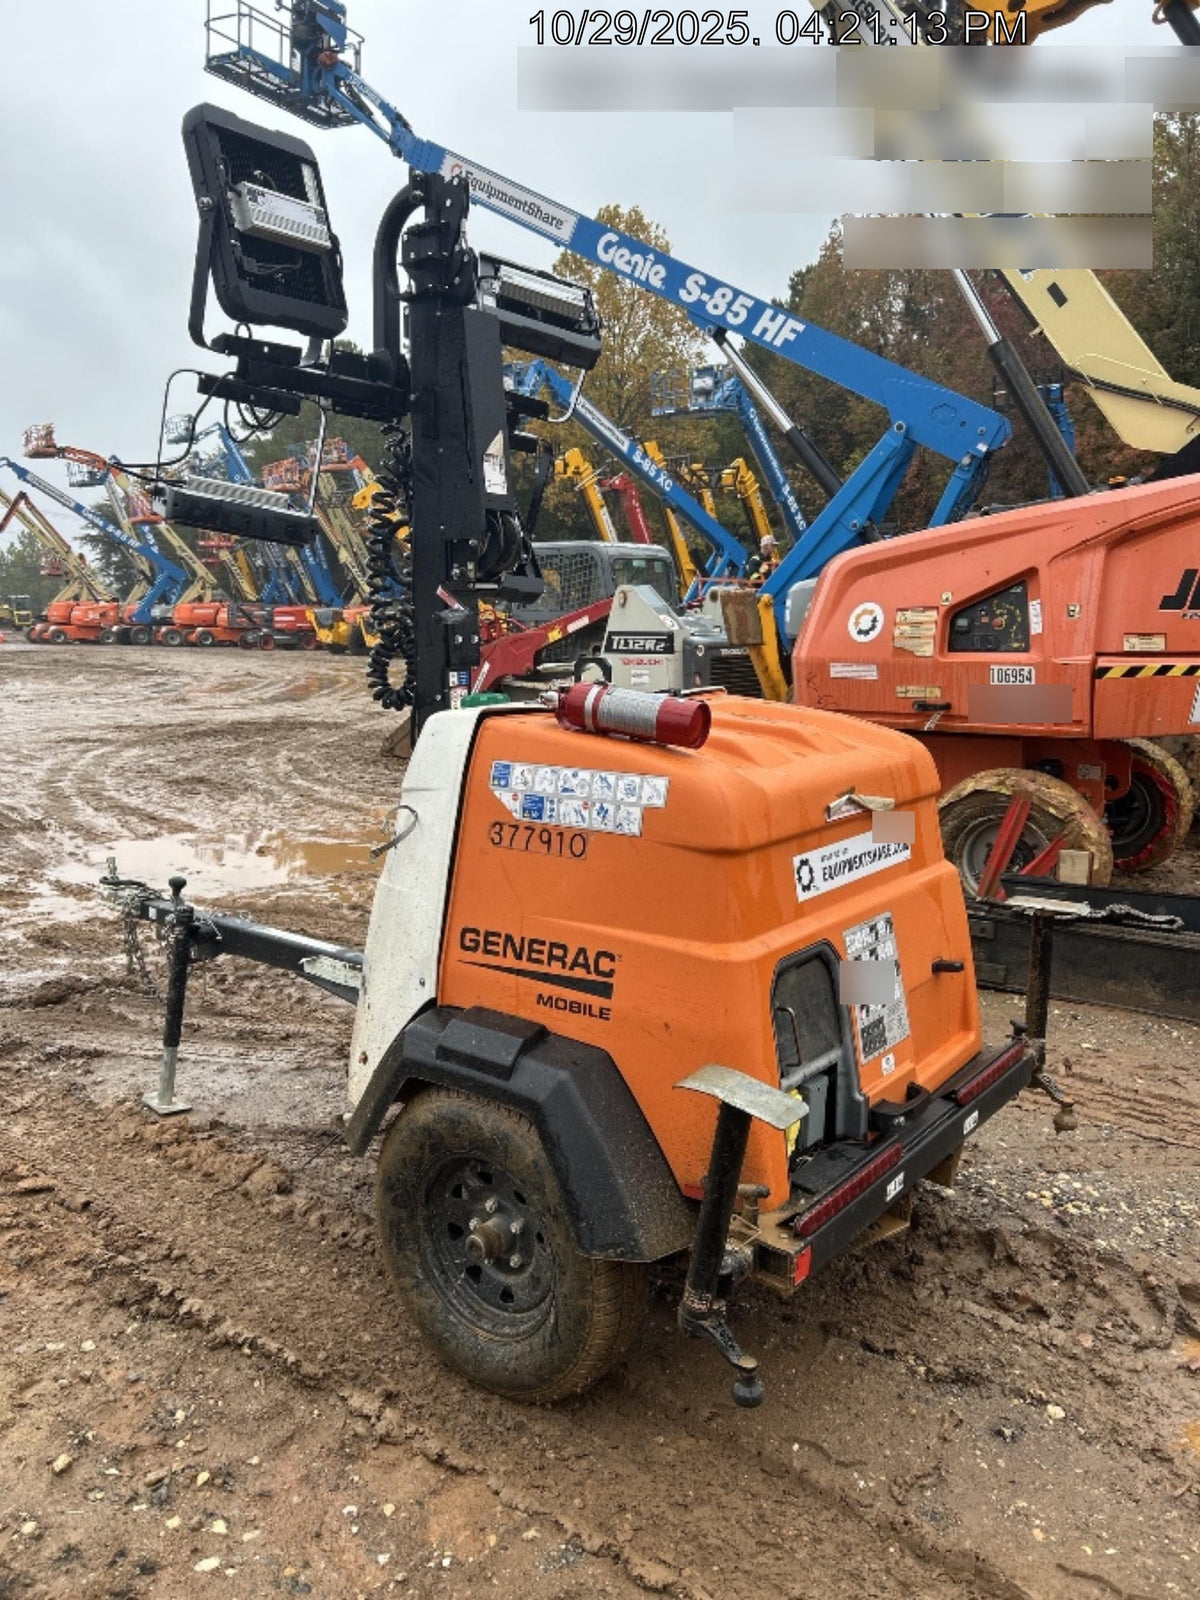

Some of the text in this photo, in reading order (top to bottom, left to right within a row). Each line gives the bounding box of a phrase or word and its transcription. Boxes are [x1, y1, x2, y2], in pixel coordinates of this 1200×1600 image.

[597, 232, 806, 347] Genie S-85 HF
[989, 667, 1032, 684] 106954
[490, 821, 587, 859] 377910
[460, 926, 616, 978] GENERAC
[536, 993, 612, 1021] MOBILE
